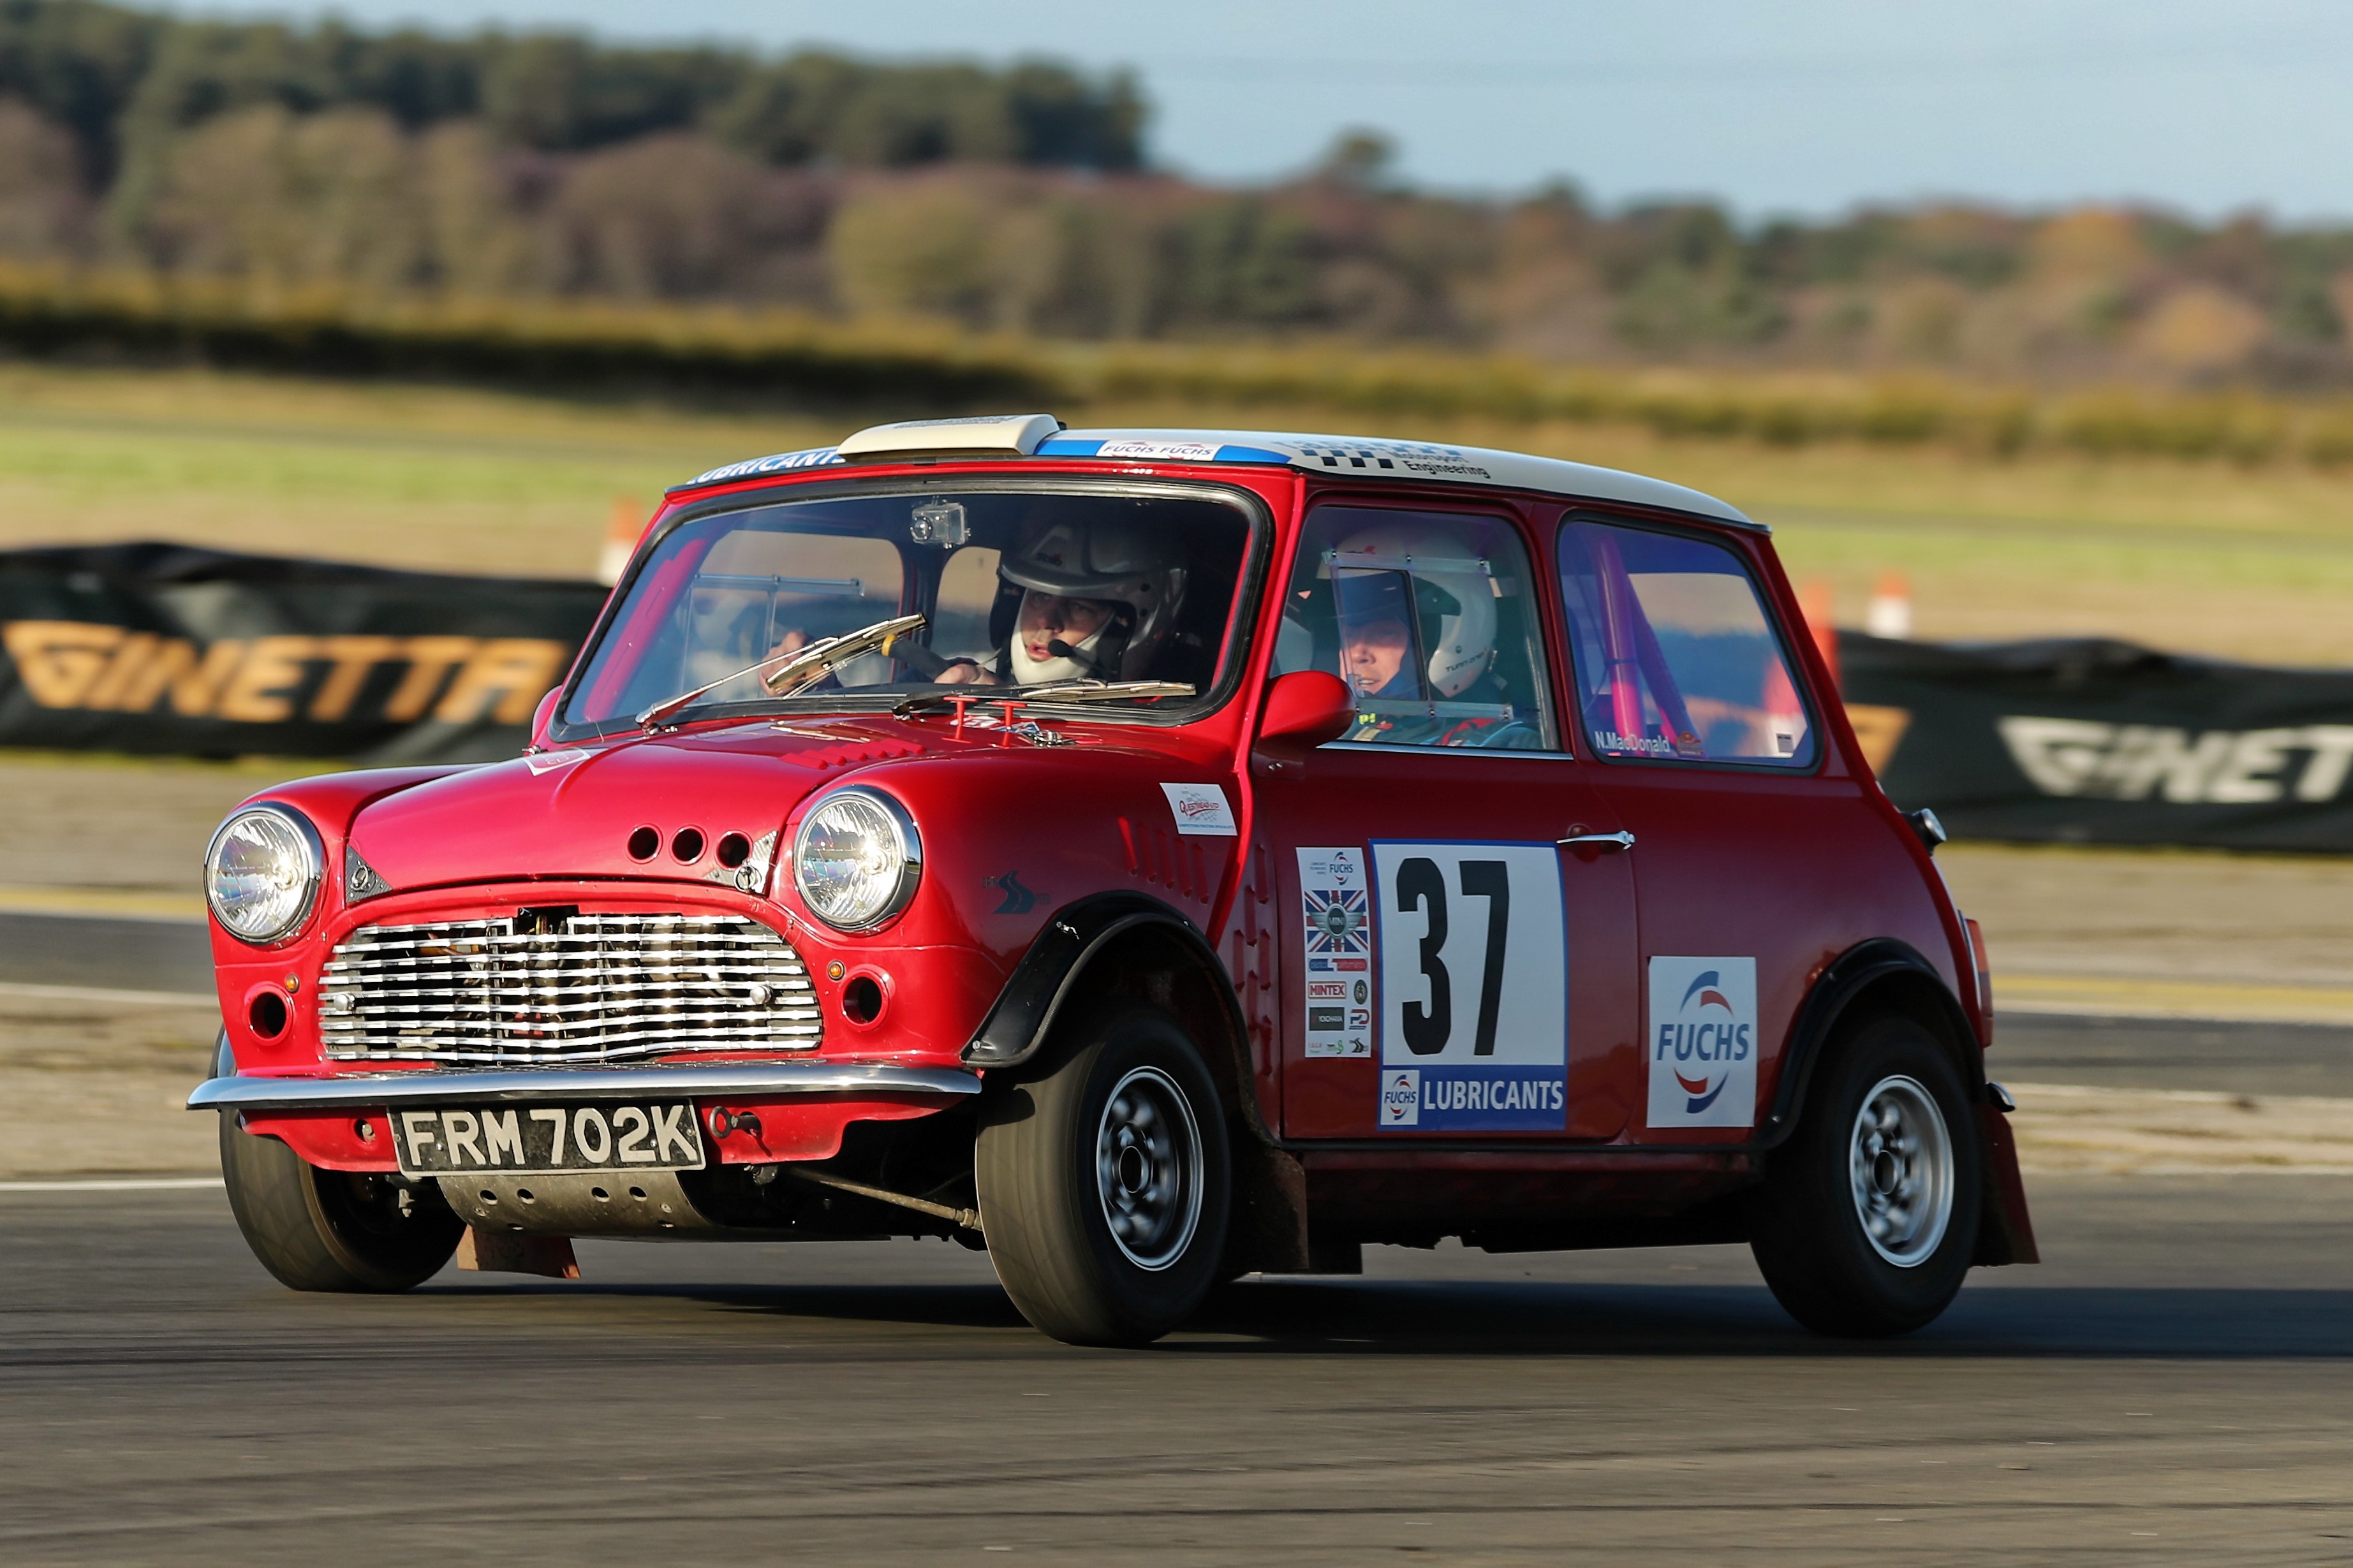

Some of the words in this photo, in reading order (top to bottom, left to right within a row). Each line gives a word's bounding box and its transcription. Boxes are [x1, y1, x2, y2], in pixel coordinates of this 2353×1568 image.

[1103, 445, 1154, 453] FUCHS
[1160, 446, 1213, 456] FUCHS
[1402, 460, 1491, 479] Engineering
[1, 619, 568, 723] GINETTA
[1595, 731, 1670, 752] N.MacDonald
[1329, 863, 1354, 874] FUCHS
[1396, 856, 1510, 1056] 37
[1310, 985, 1345, 995] MINTEX
[1656, 1023, 1750, 1062] FUCHS
[1384, 1091, 1417, 1104] FUCHS
[1424, 1080, 1563, 1110] LUBRICANTS
[401, 1108, 526, 1166] FRM
[529, 1104, 699, 1165] 702K
